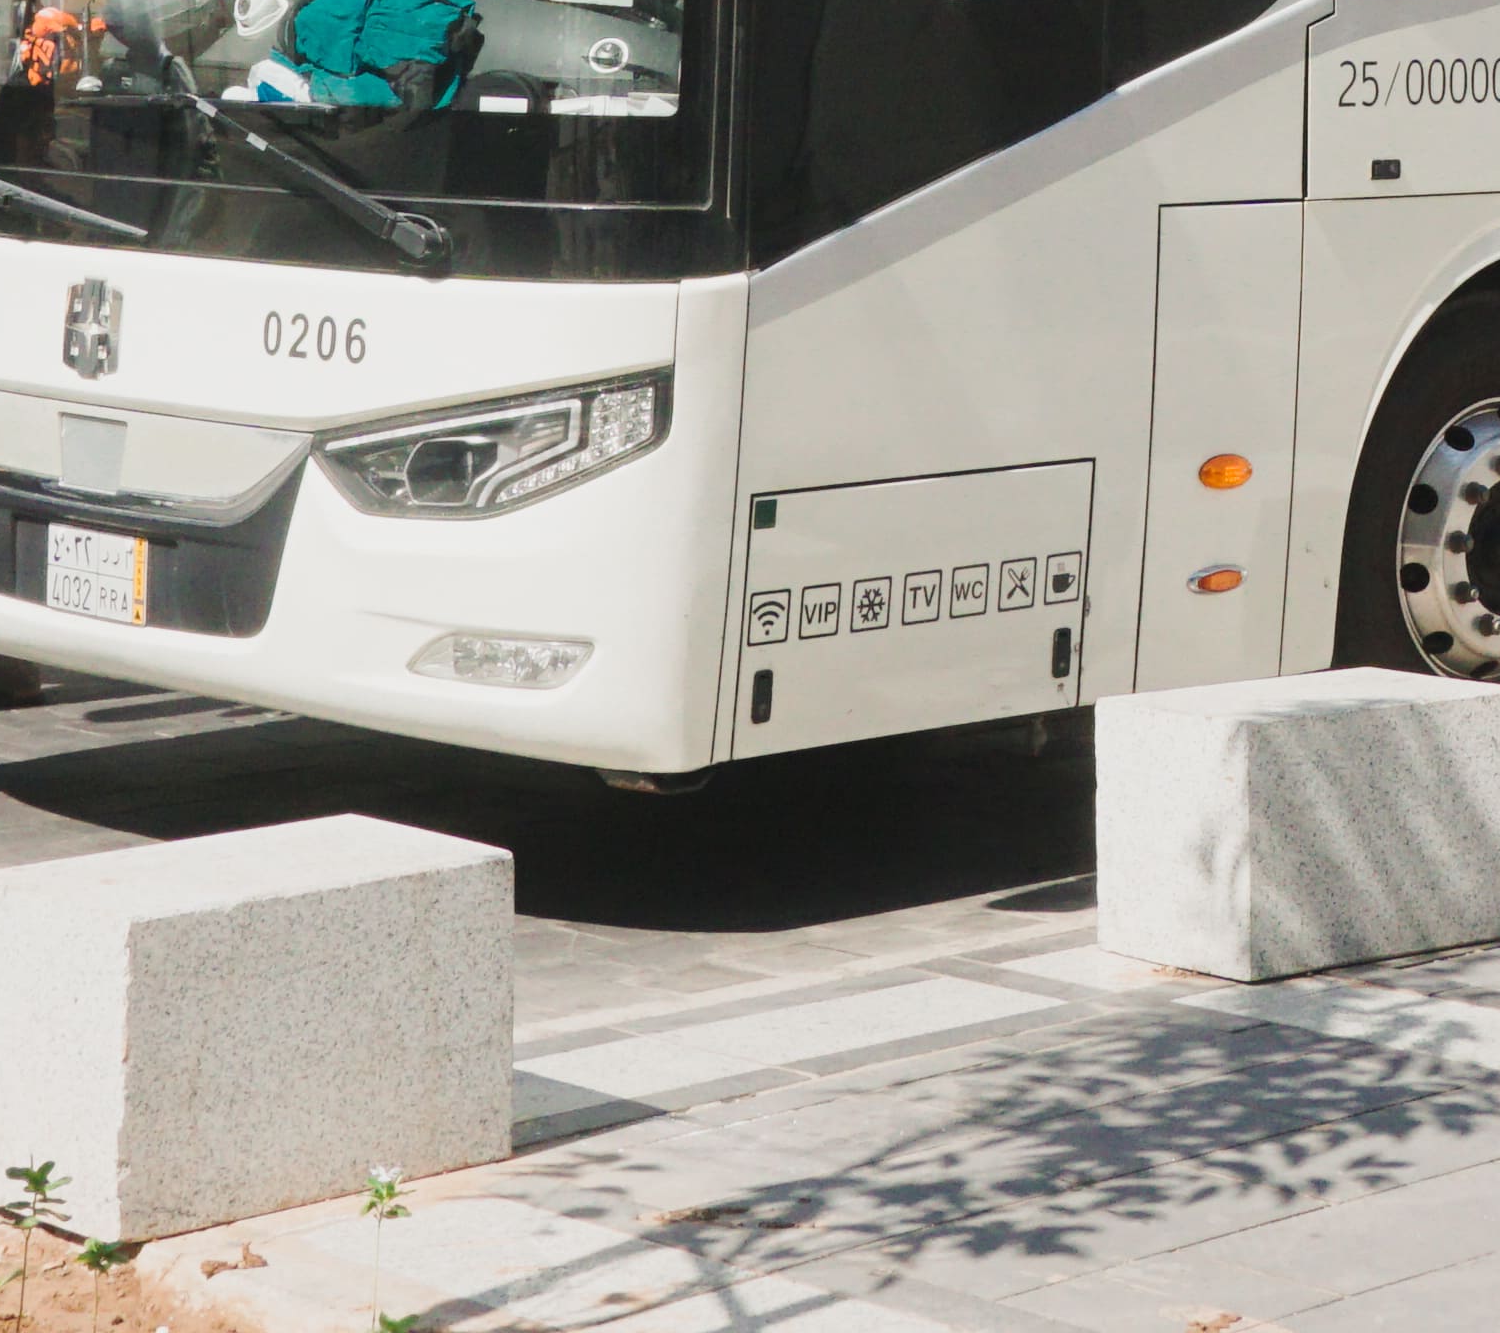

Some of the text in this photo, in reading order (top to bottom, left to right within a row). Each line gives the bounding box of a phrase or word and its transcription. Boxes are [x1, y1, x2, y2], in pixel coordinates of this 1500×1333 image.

[263, 310, 367, 365] 0206
[52, 572, 92, 611] 4032
[803, 580, 984, 625] VIP TV WC
